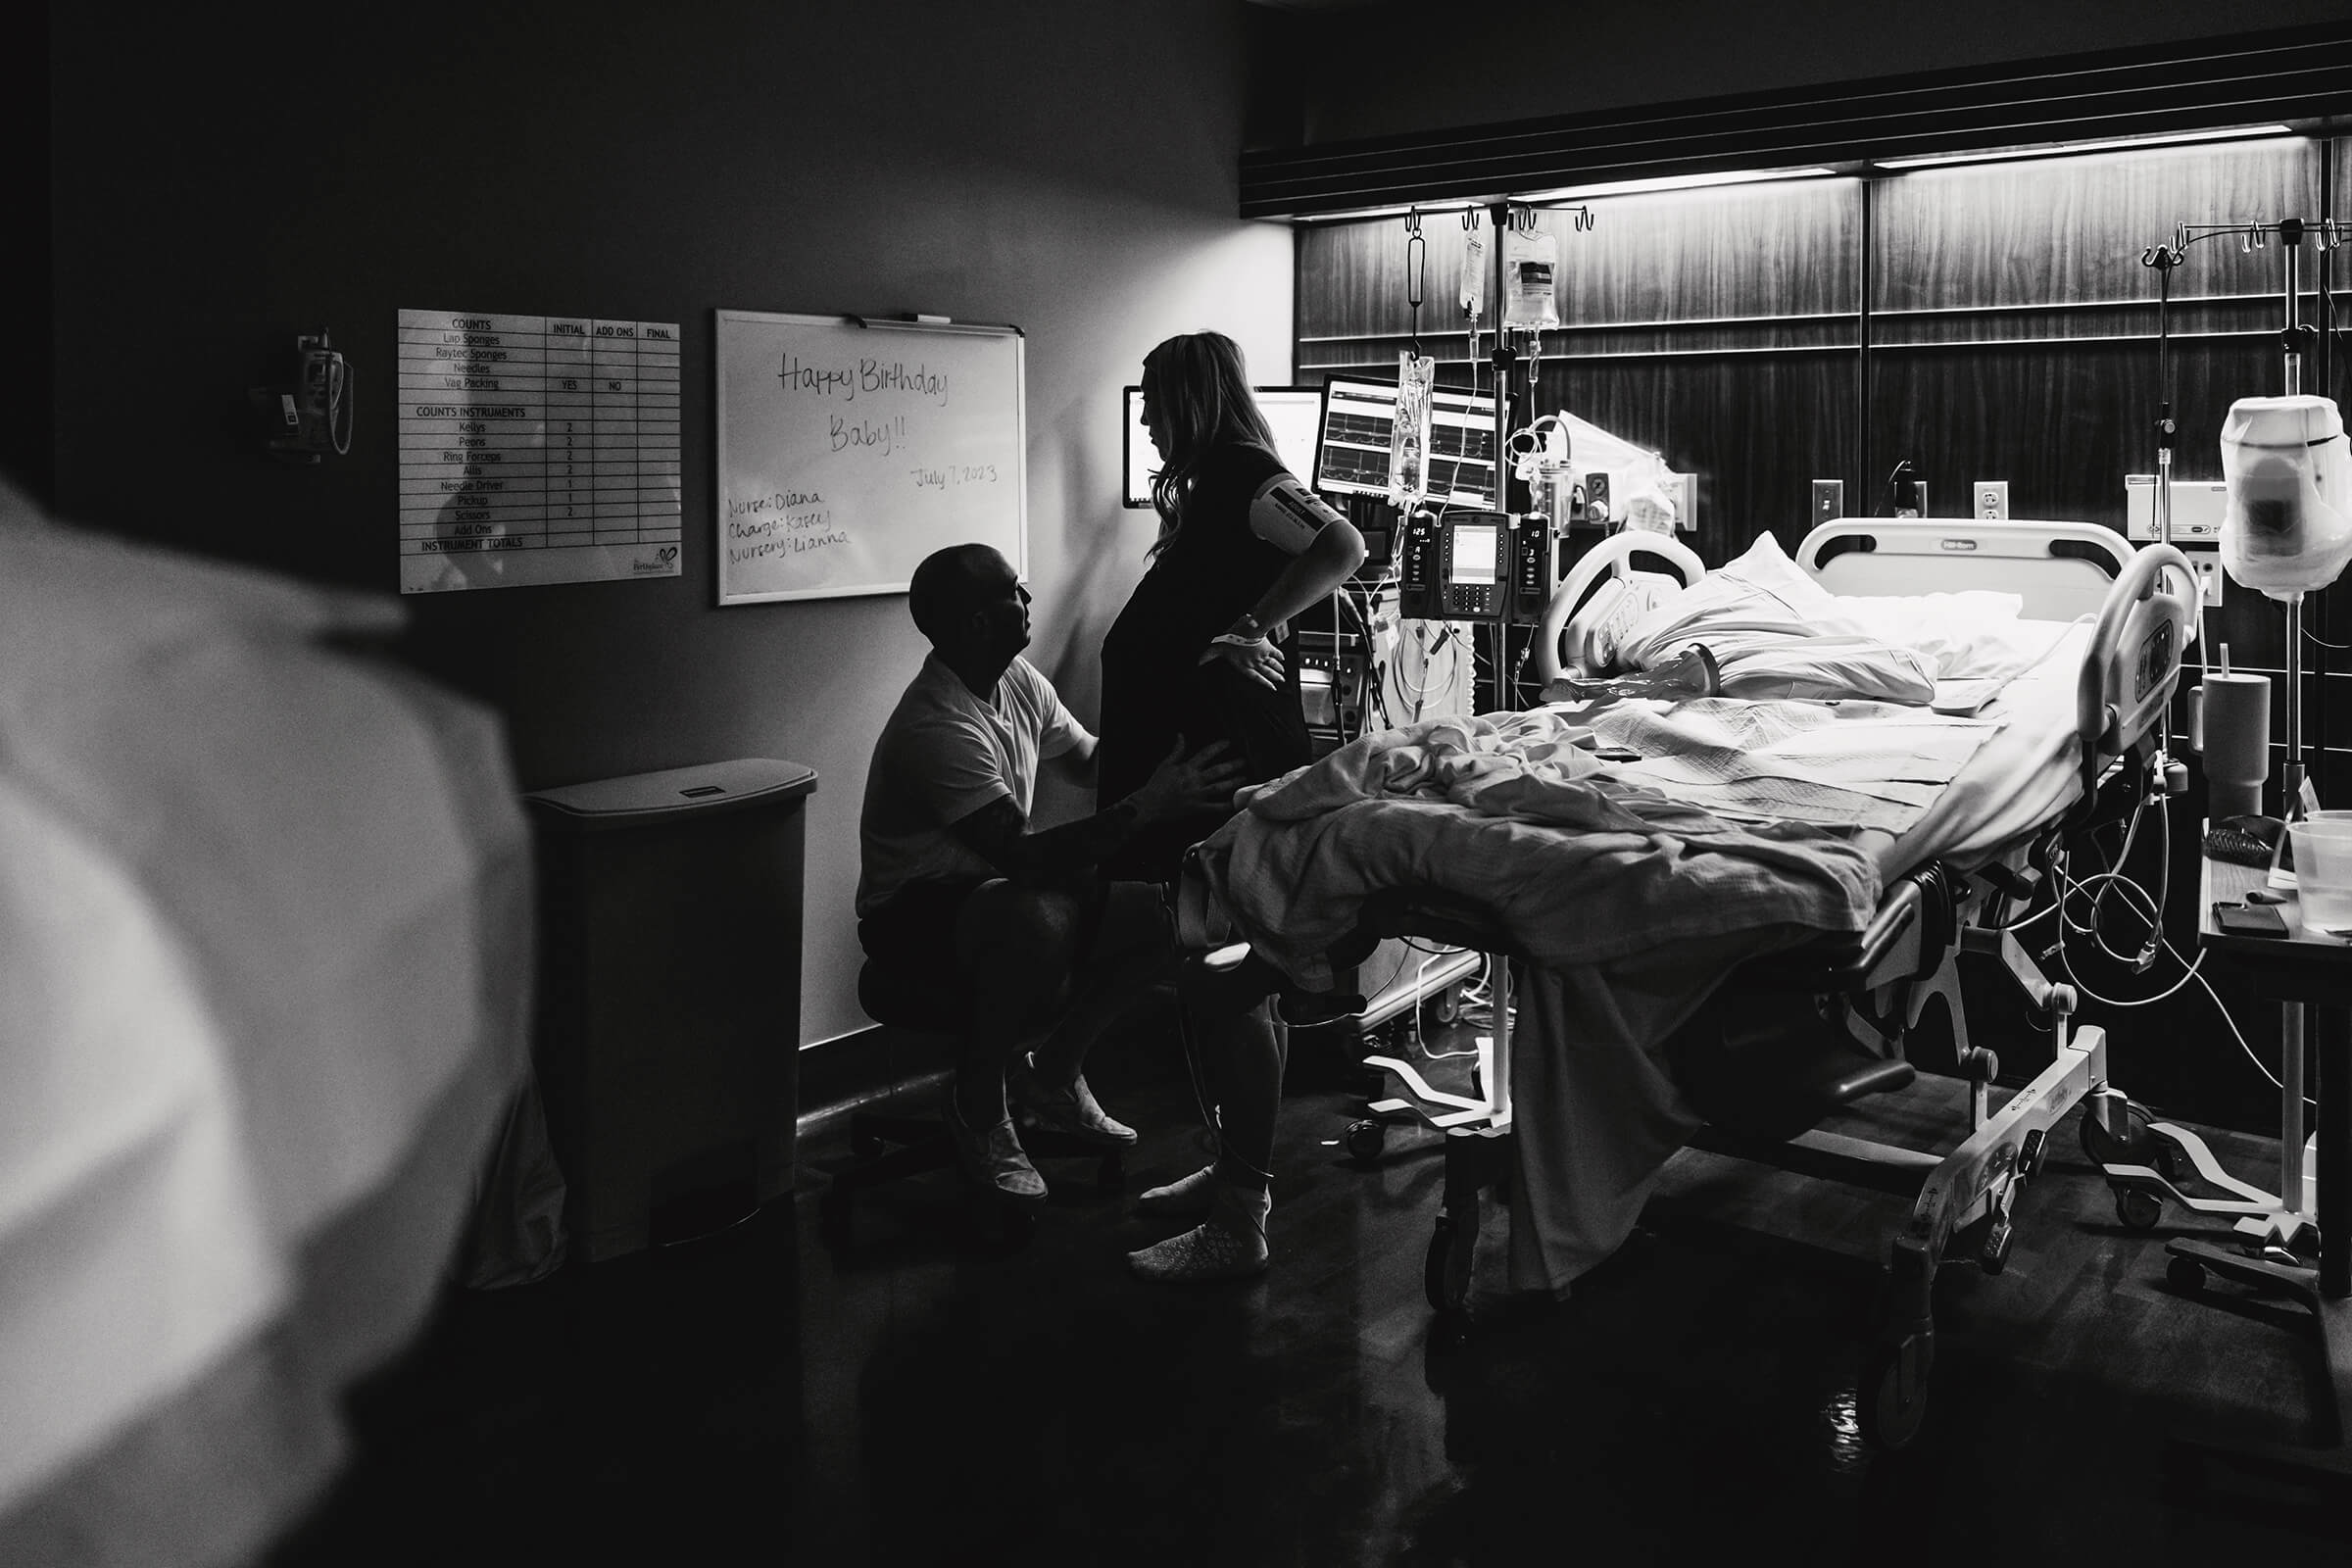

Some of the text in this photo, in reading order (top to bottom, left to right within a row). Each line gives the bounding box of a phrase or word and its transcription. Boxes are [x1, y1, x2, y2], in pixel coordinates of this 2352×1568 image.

[452, 318, 671, 339] COUNTS INITIAL ADD ONS FINAL
[443, 333, 501, 346] Lap Sponges
[435, 347, 508, 361] Raytec Sponges
[453, 363, 491, 373] Needles
[444, 376, 621, 391] Vag Packing YES NO
[777, 352, 949, 408] Happy Birthday
[416, 406, 526, 417] COUNTS INSTRUMENTS
[459, 421, 573, 434] Kellys 2
[567, 437, 573, 447] 2
[830, 415, 906, 458] Baby!!
[443, 451, 573, 465] Ring Forceps 2
[463, 465, 573, 475] Allis 2
[909, 468, 946, 491] July
[962, 464, 998, 482] 2023
[441, 481, 473, 492] Needle
[476, 480, 504, 490] Driver
[458, 495, 488, 507] Pickup
[728, 489, 825, 517] Nurse: Diana
[455, 507, 573, 521] Scissors 2
[455, 524, 492, 535] Add Ons
[728, 518, 784, 540] Charge:
[421, 537, 523, 552] INSTRUMENT TOTALS
[729, 531, 853, 565] Nursery: Lianna
